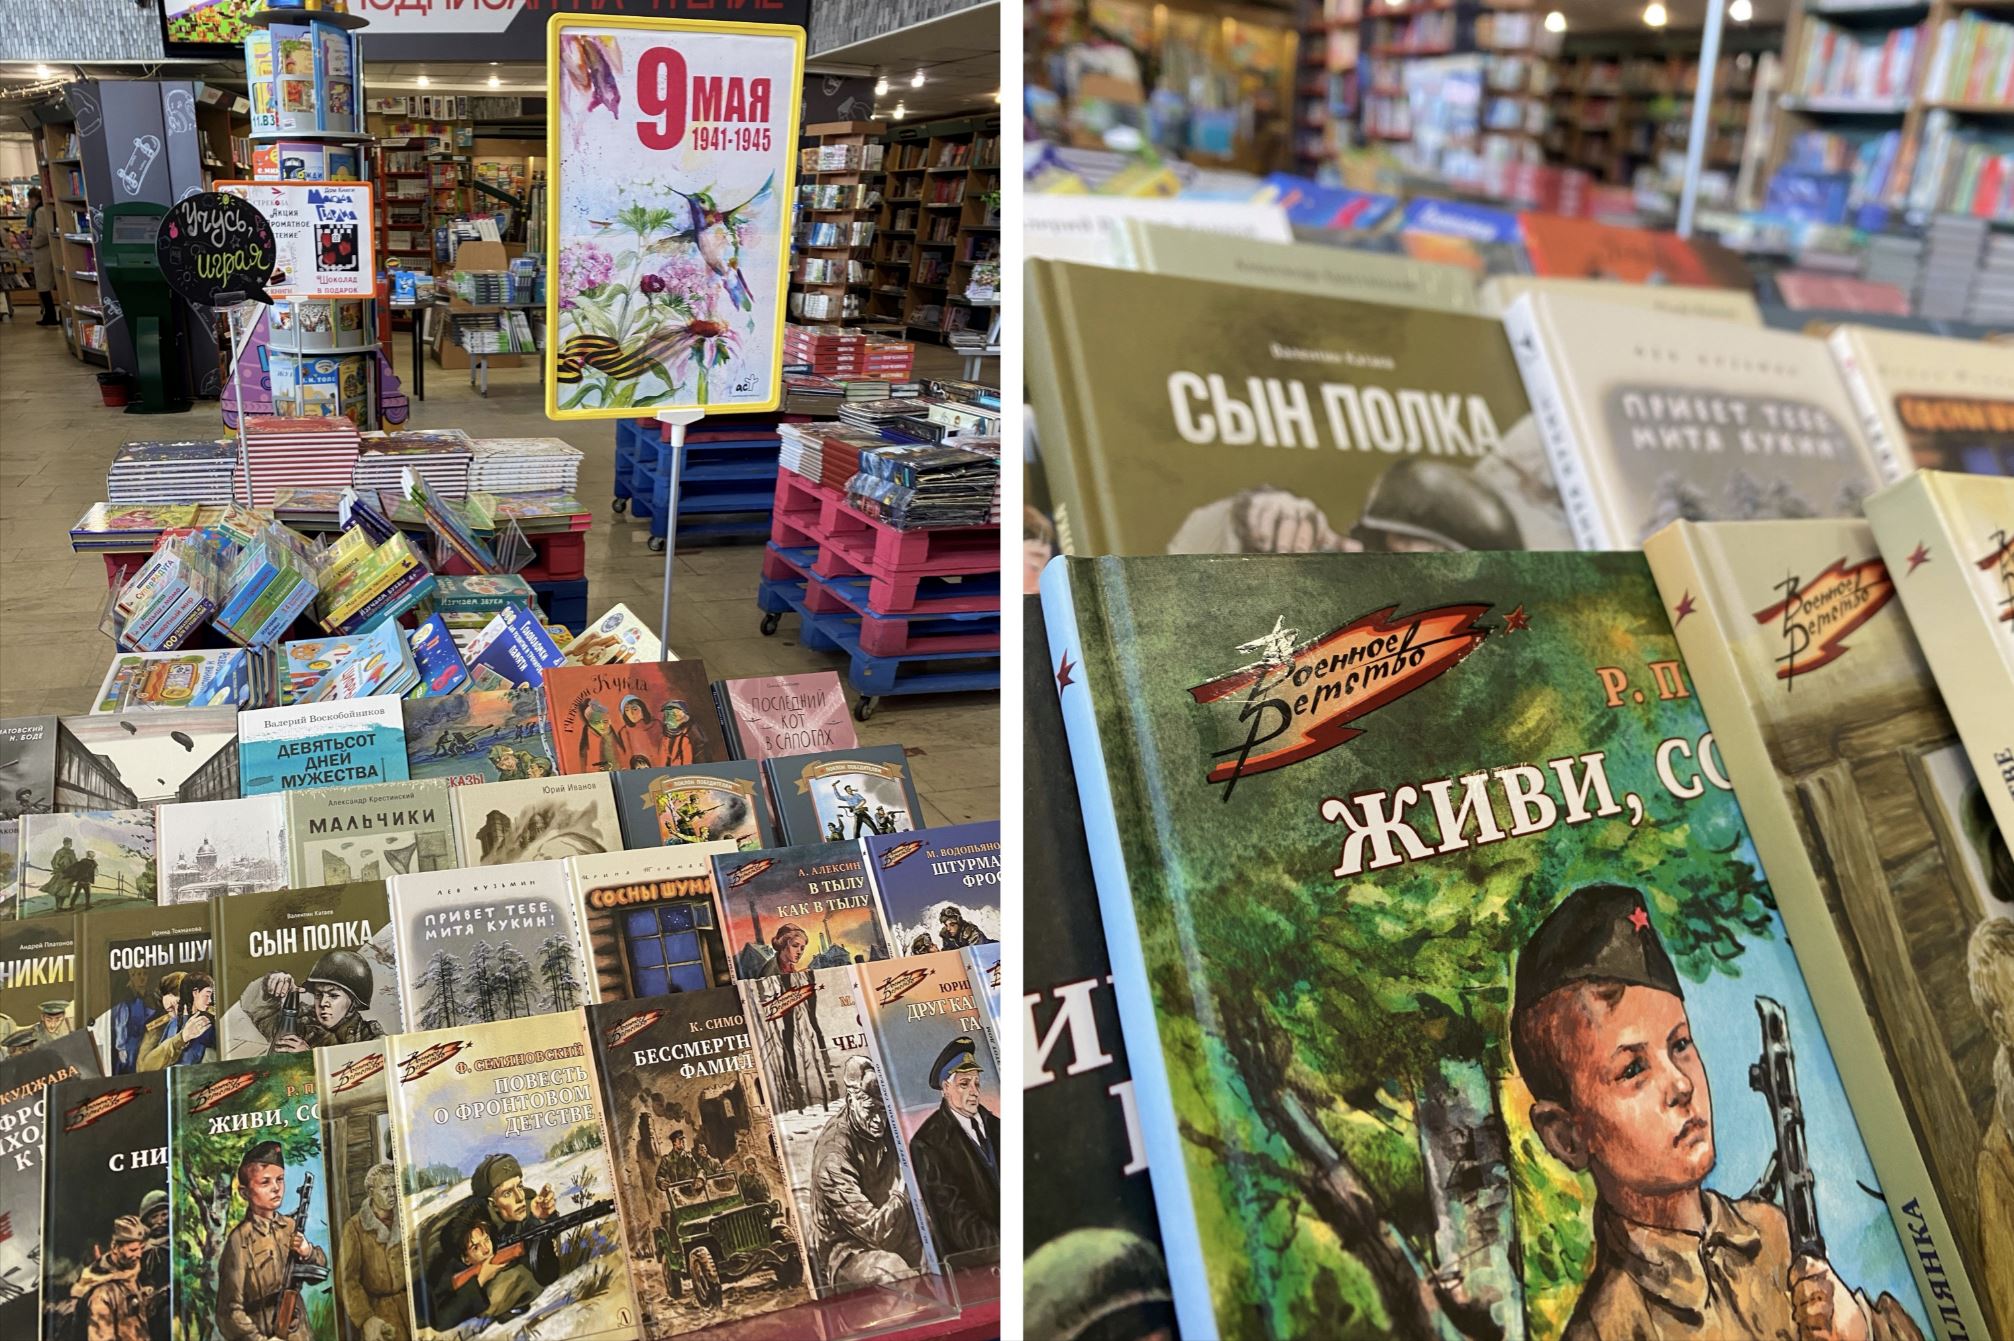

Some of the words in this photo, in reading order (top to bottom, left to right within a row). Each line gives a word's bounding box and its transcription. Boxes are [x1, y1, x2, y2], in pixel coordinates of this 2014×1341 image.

[637, 47, 687, 150] 9
[692, 76, 771, 122] МАЯ
[692, 127, 771, 151] 1941-1945
[198, 243, 271, 288] играя
[1167, 370, 1320, 450] СЫН
[1319, 381, 1503, 456] ПОЛКА
[1596, 667, 1643, 708] Р.
[752, 689, 826, 713] ПОСЛЕДНИЙ
[264, 715, 307, 729] Валерий
[309, 707, 386, 724] Воскобойников
[781, 713, 805, 728] КОТ
[277, 733, 376, 760] ДЕВЯТЬСОТ
[775, 729, 833, 750] САПОГАХ
[305, 749, 351, 772] ДНЕЙ
[281, 765, 378, 789] МУЖЕСТВА
[309, 808, 435, 834] МАЛЬЧИКИ
[1321, 750, 1645, 878] ЖИВИ,
[812, 862, 861, 875] АЛЕКСИН
[591, 883, 658, 907] СОСНЫ
[808, 882, 818, 895] В
[821, 877, 864, 892] ТЫЛУ
[425, 907, 496, 927] ПРИВЕТ
[777, 903, 809, 918] КАК
[814, 901, 824, 913] В
[826, 894, 869, 911] ТЫЛУ
[249, 927, 297, 958] СЫН
[303, 919, 373, 950] ПОЛКА
[425, 925, 474, 941] МИТЯ
[487, 914, 556, 933] КУКИН!
[109, 943, 173, 971] СОСНЫ
[906, 999, 947, 1022] ДРУГ
[689, 1022, 702, 1033] К.
[705, 1015, 747, 1029] СИМО
[455, 1061, 472, 1074] Ф.
[474, 1042, 584, 1072] СЕМЯНОВСКИЙ
[286, 1086, 299, 1097] Р.
[494, 1065, 589, 1095] ПОВЕСТЬ
[433, 1108, 449, 1125] О
[456, 1084, 591, 1121] ФРОНТОВОМ
[208, 1108, 289, 1135] ЖИВИ,
[505, 1104, 595, 1138] ДЕТСТВЕ
[14, 1150, 33, 1171] К
[109, 1153, 124, 1172] С
